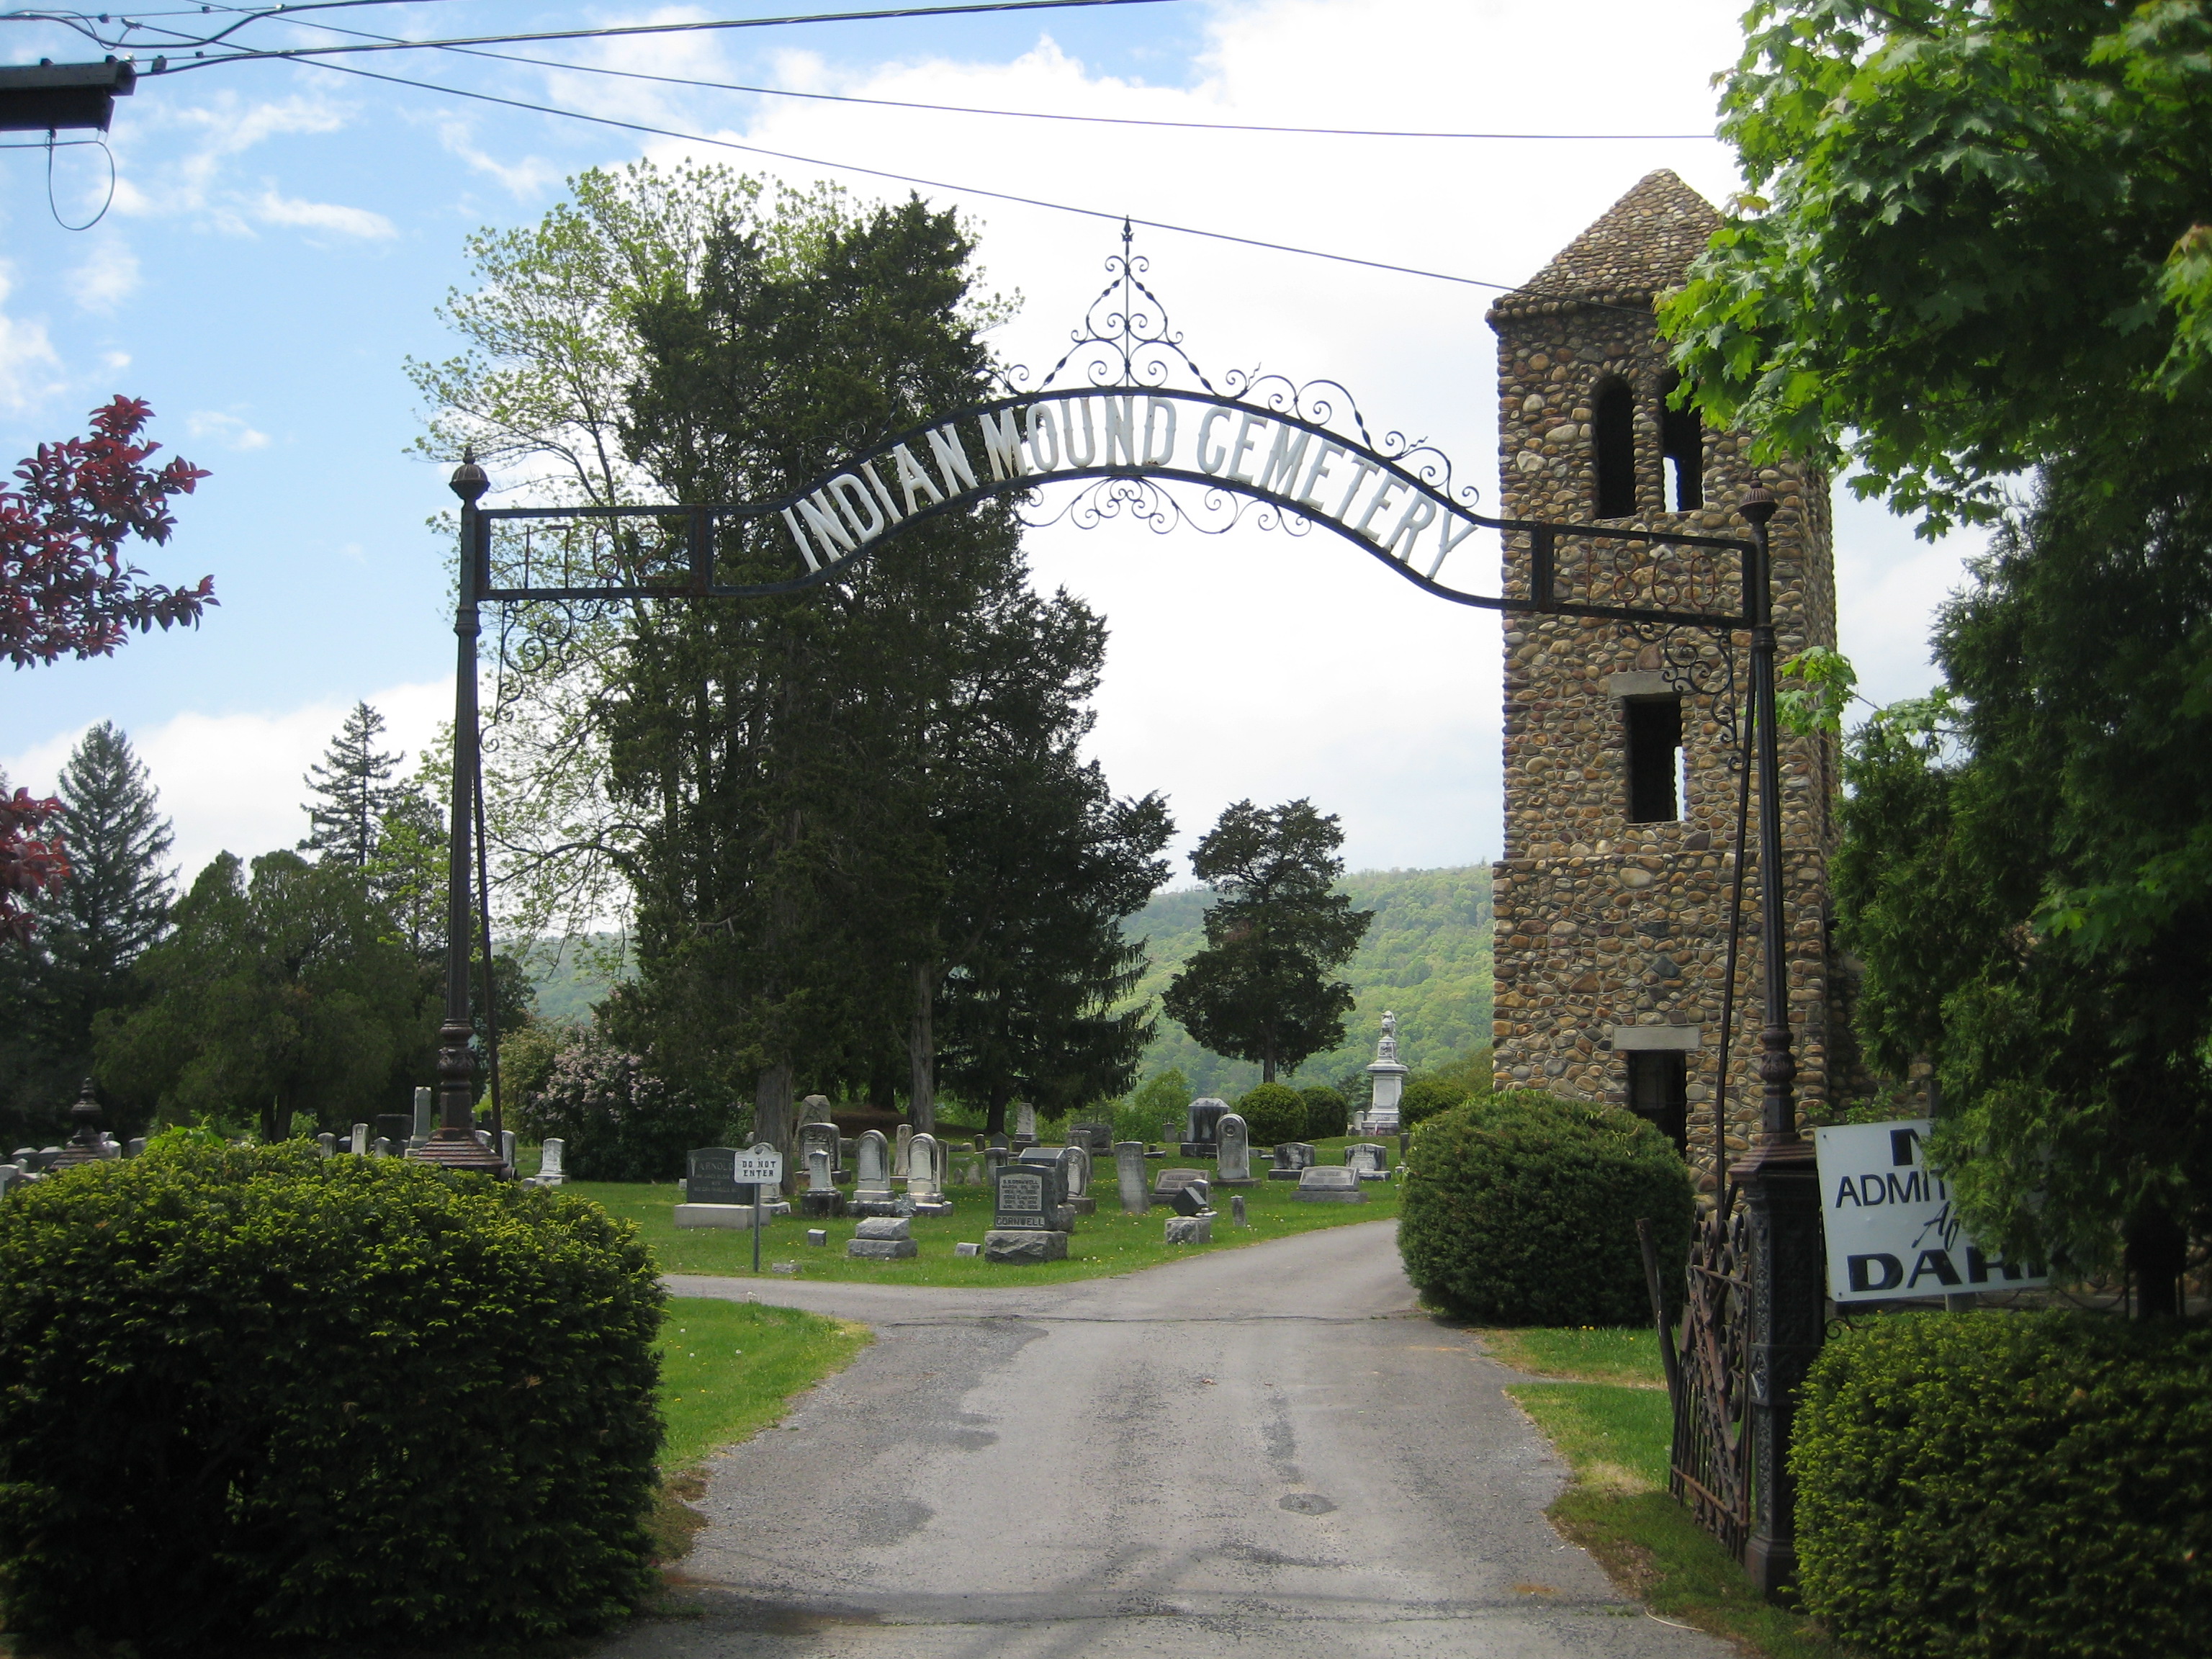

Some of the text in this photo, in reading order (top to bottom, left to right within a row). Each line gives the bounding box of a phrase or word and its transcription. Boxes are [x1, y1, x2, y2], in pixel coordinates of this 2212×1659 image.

[781, 395, 1478, 580] INDIAN MOUND CEMETERY
[525, 523, 666, 589] 1762
[1587, 544, 1715, 612] 1860
[997, 1216, 1043, 1226] CORNWELL
[1847, 1246, 2049, 1292] DAR
